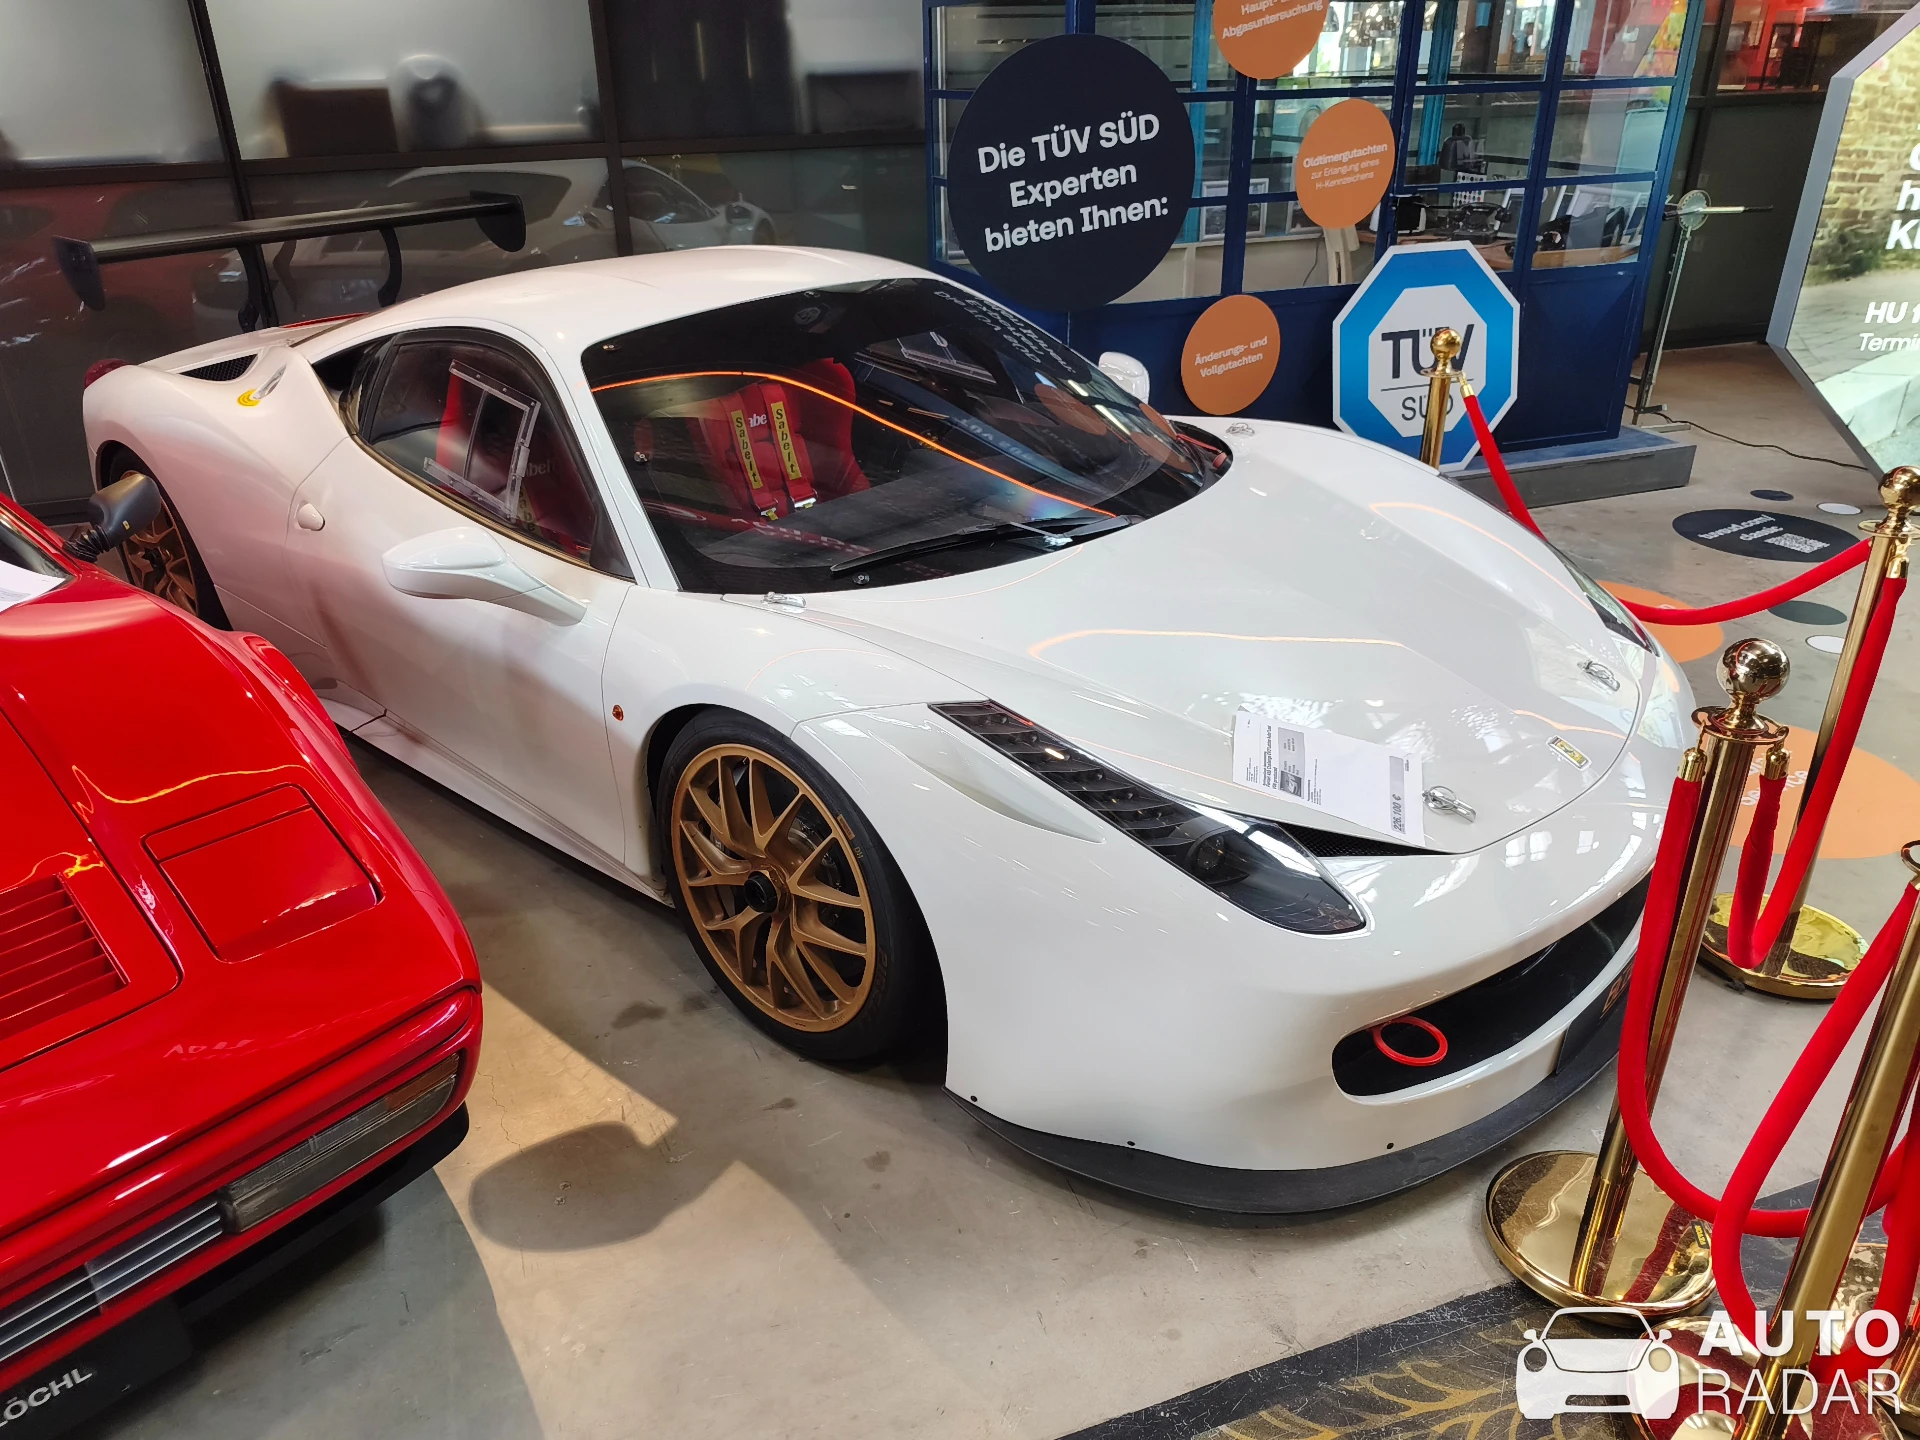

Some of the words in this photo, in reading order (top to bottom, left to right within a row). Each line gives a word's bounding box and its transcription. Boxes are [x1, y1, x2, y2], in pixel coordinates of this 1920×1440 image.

[1222, 1, 1324, 39] Abgasuntersuchung
[977, 142, 1026, 173] Die
[1031, 124, 1091, 162] TÜV
[1099, 110, 1160, 148] SÜD
[1303, 143, 1388, 168] Oldtimergutachten
[1009, 164, 1137, 207] Experten
[1311, 171, 1323, 180] zur
[1323, 163, 1359, 177] Erlangung
[1360, 159, 1380, 168] eines
[984, 217, 1074, 252] bieten
[1079, 197, 1169, 232] Ihnen:
[1864, 302, 1908, 323] HU
[1194, 344, 1249, 366] Änderungs-
[1249, 336, 1268, 349] und
[1200, 353, 1263, 378] Vollgutachten
[735, 416, 758, 483] Sabelt
[775, 408, 796, 474] Sabelt
